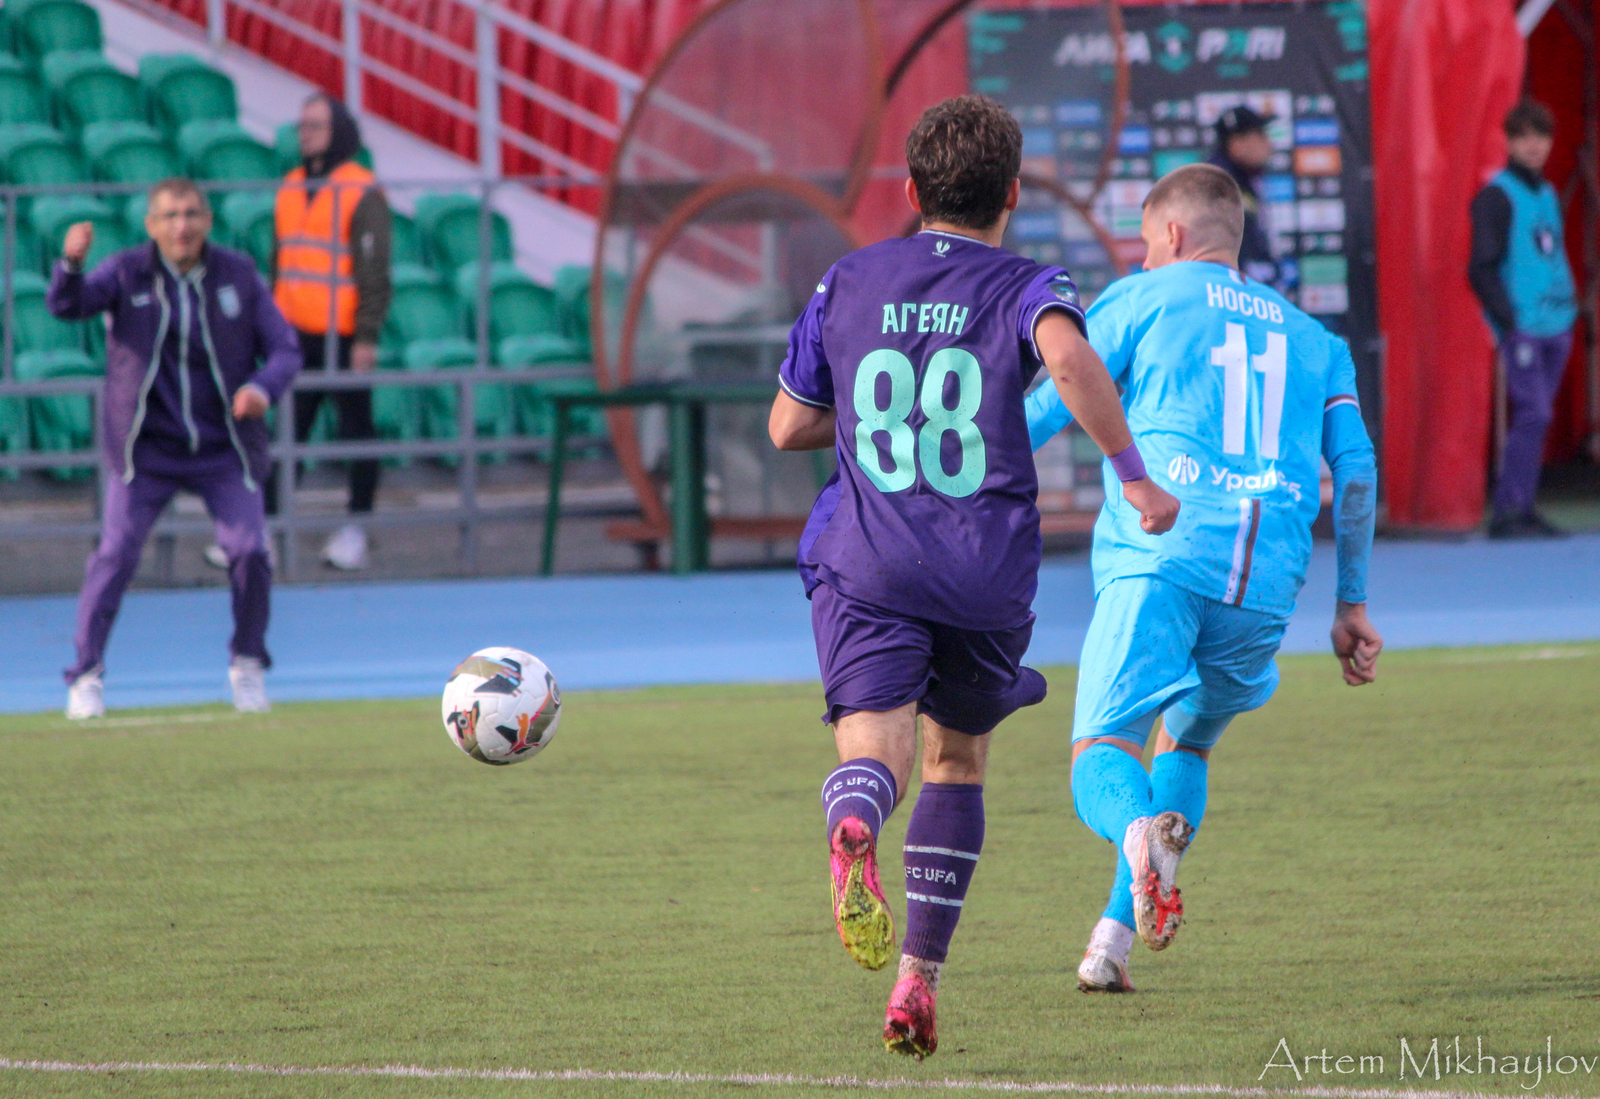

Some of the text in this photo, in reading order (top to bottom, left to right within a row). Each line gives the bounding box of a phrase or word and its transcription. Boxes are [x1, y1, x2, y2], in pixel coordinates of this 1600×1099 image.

[881, 302, 969, 335] АГЕЯН
[1206, 282, 1284, 324] НОСОВ
[1210, 321, 1287, 460] 11
[853, 347, 987, 498] 88
[825, 776, 879, 802] FC UFA
[904, 866, 957, 885] FC UFA
